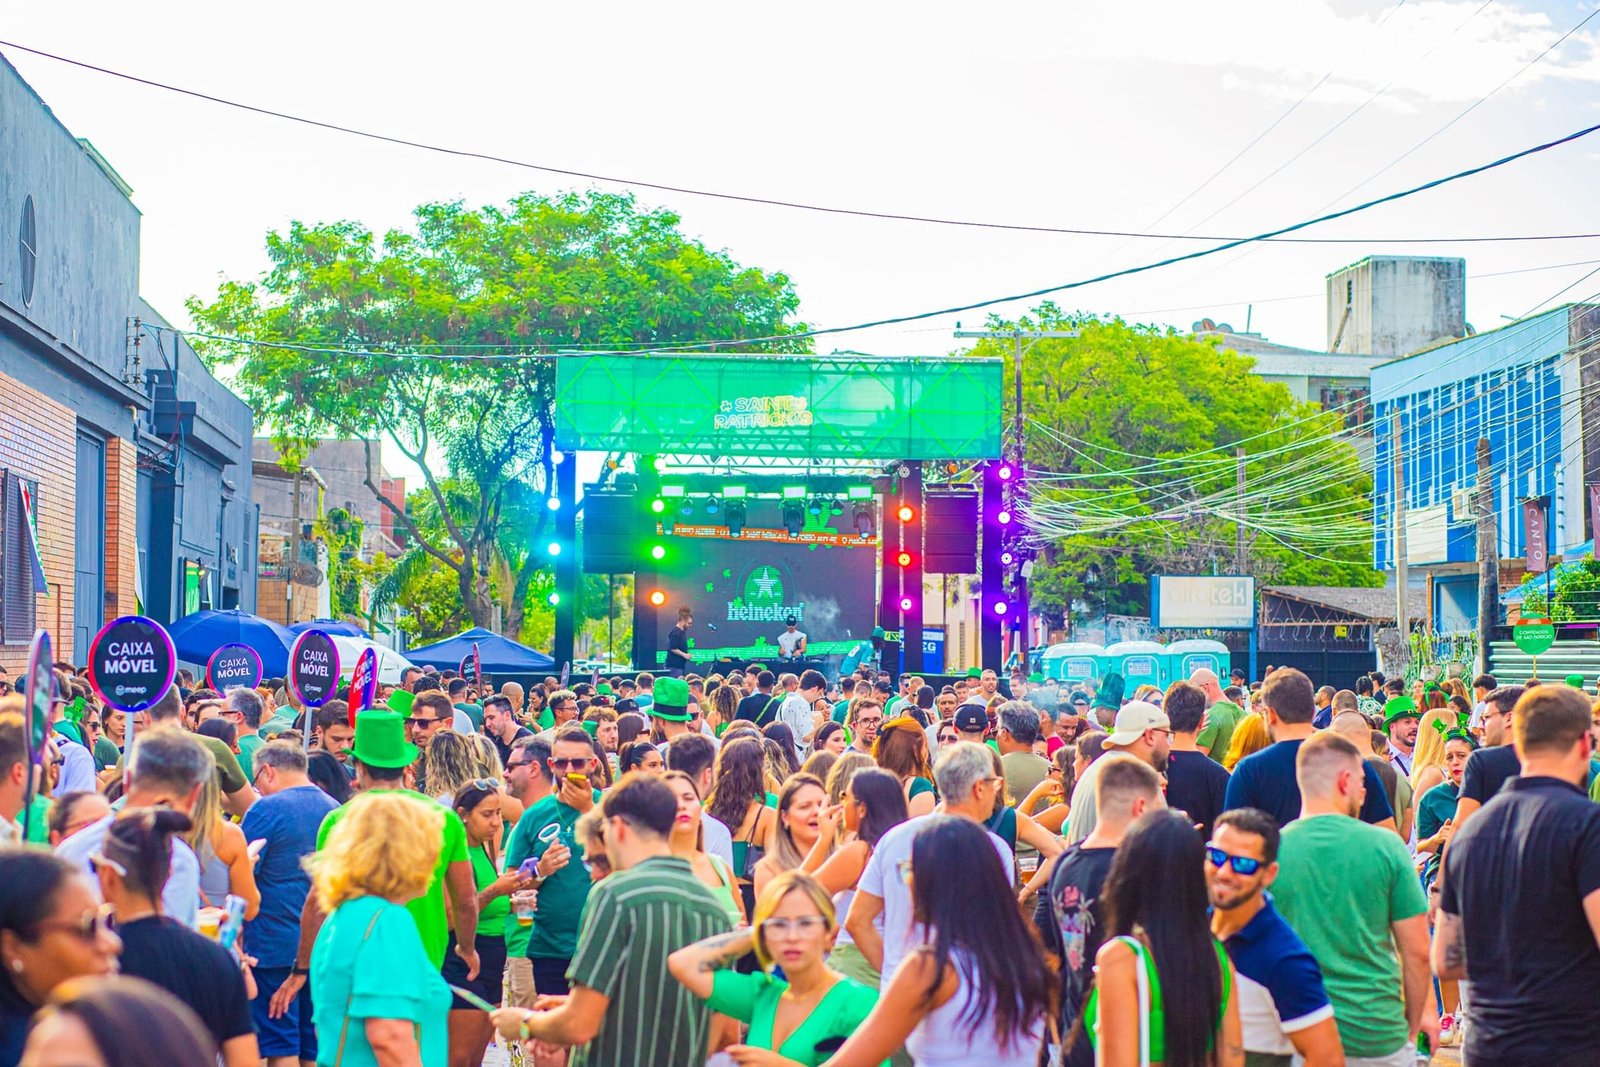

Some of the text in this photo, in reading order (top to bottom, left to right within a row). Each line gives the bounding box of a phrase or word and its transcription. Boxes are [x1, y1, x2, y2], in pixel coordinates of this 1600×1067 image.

[1528, 508, 1542, 560] CANTO
[108, 642, 154, 656] CAIXA
[303, 649, 328, 663] CAIXA
[104, 656, 157, 674] MÓVEL
[219, 657, 248, 668] CAIXA
[300, 661, 329, 677] MÓVEL
[217, 667, 251, 679] MÓVEL
[124, 686, 147, 695] meep
